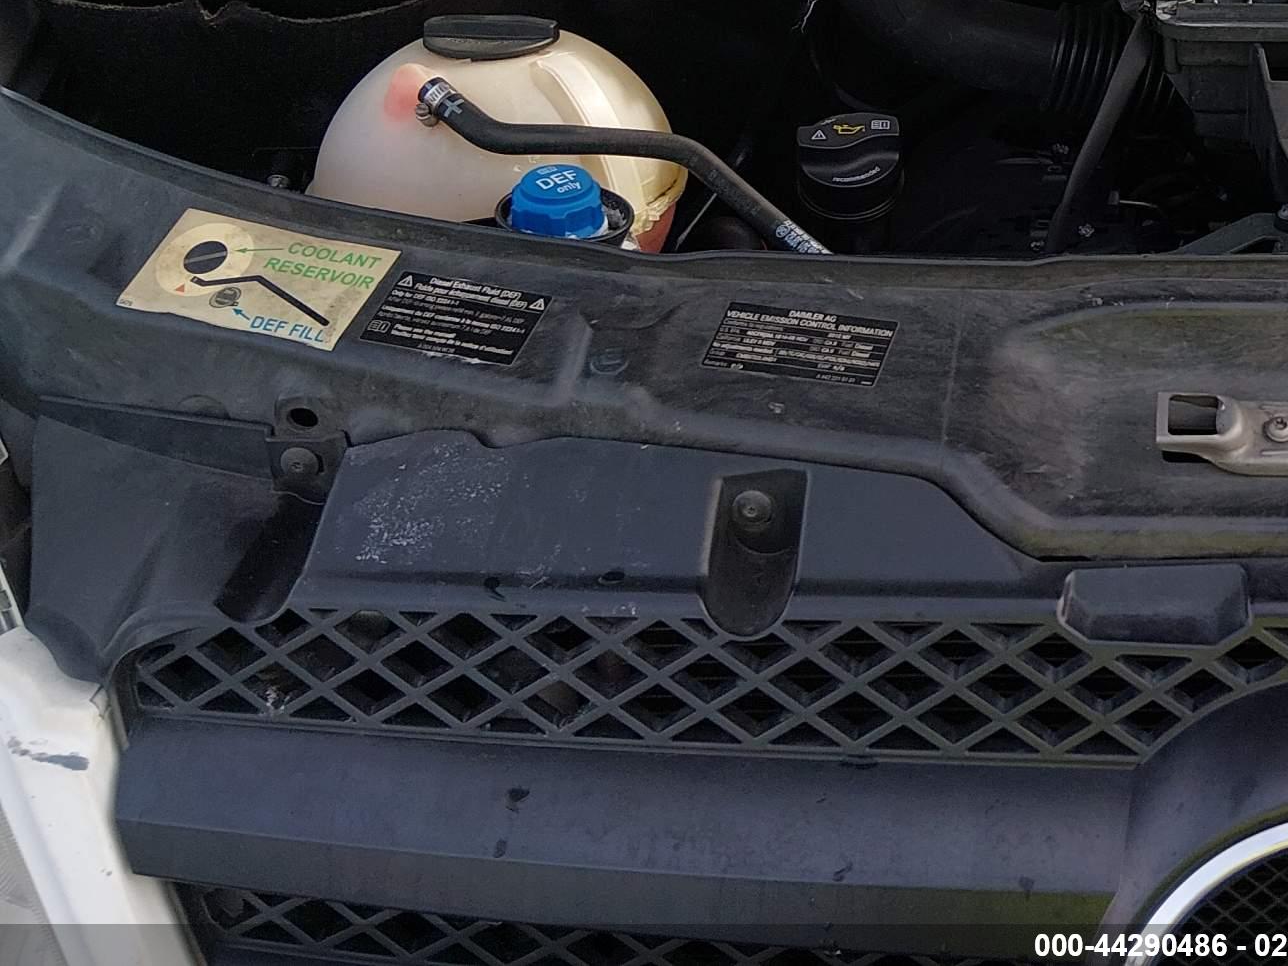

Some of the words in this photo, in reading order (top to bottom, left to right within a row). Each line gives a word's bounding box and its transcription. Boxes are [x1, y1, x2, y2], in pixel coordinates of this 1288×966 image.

[535, 169, 577, 190] DEF
[832, 165, 881, 183] recommended
[557, 181, 582, 194] only
[287, 241, 383, 270] COOLANT
[263, 257, 376, 290] RESERVOIR
[429, 278, 454, 287] Diesel
[452, 282, 482, 292] Exhaust
[481, 287, 502, 295] Fluid
[499, 290, 522, 300] (DEF)
[726, 310, 760, 320] VEHICLE
[760, 315, 799, 325] EMISSION
[799, 319, 838, 330] CONTROL
[837, 324, 893, 337] INFORMATION
[788, 310, 825, 321] DAIMLER
[248, 314, 288, 334] DEF
[288, 320, 326, 344] FILL
